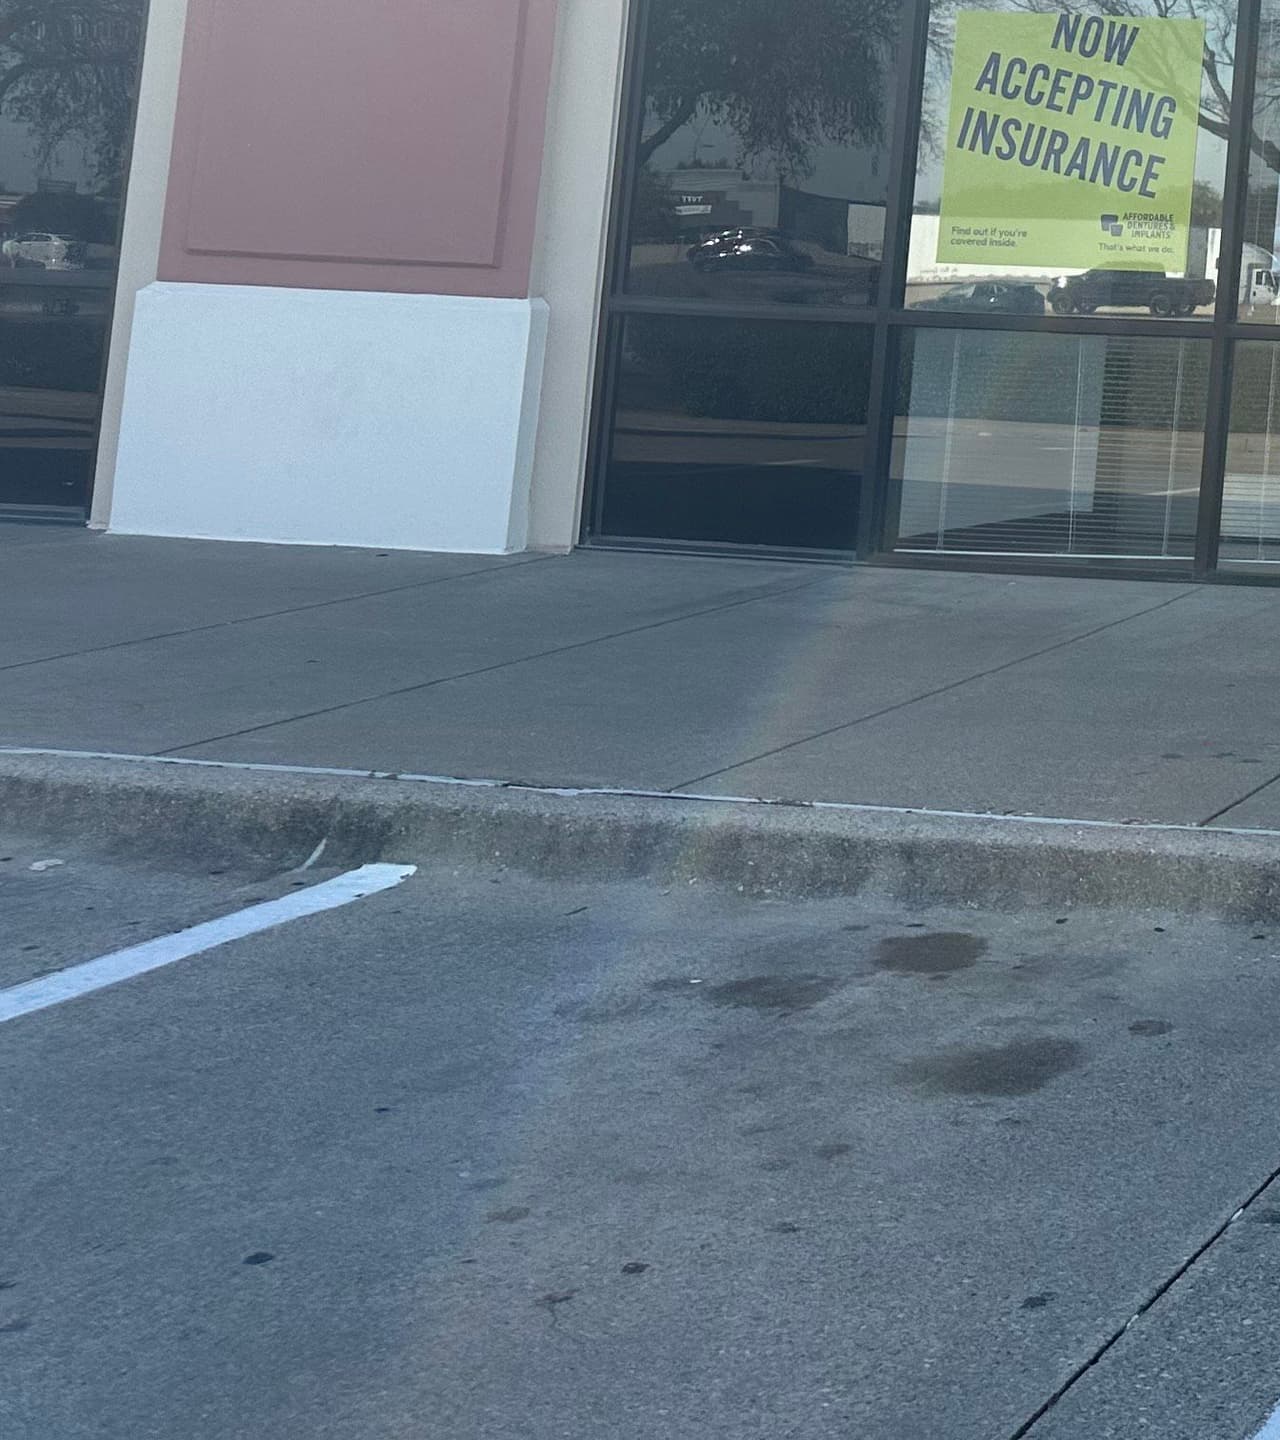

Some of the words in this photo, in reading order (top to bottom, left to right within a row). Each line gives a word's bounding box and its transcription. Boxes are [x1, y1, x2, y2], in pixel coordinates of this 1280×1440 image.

[1051, 14, 1139, 66] NOW
[974, 51, 1176, 140] ACCEPTING
[956, 107, 1166, 198] INSURANCE
[1122, 212, 1174, 223] AFFORDABLE
[1127, 221, 1168, 231] DENTURES
[951, 226, 972, 237] Find
[974, 228, 988, 237] out
[990, 228, 998, 237] if
[998, 229, 1027, 240] you're
[1131, 230, 1171, 239] IMPLANTS
[950, 237, 987, 247] covered
[1099, 243, 1124, 252] That's
[1125, 244, 1146, 253] what
